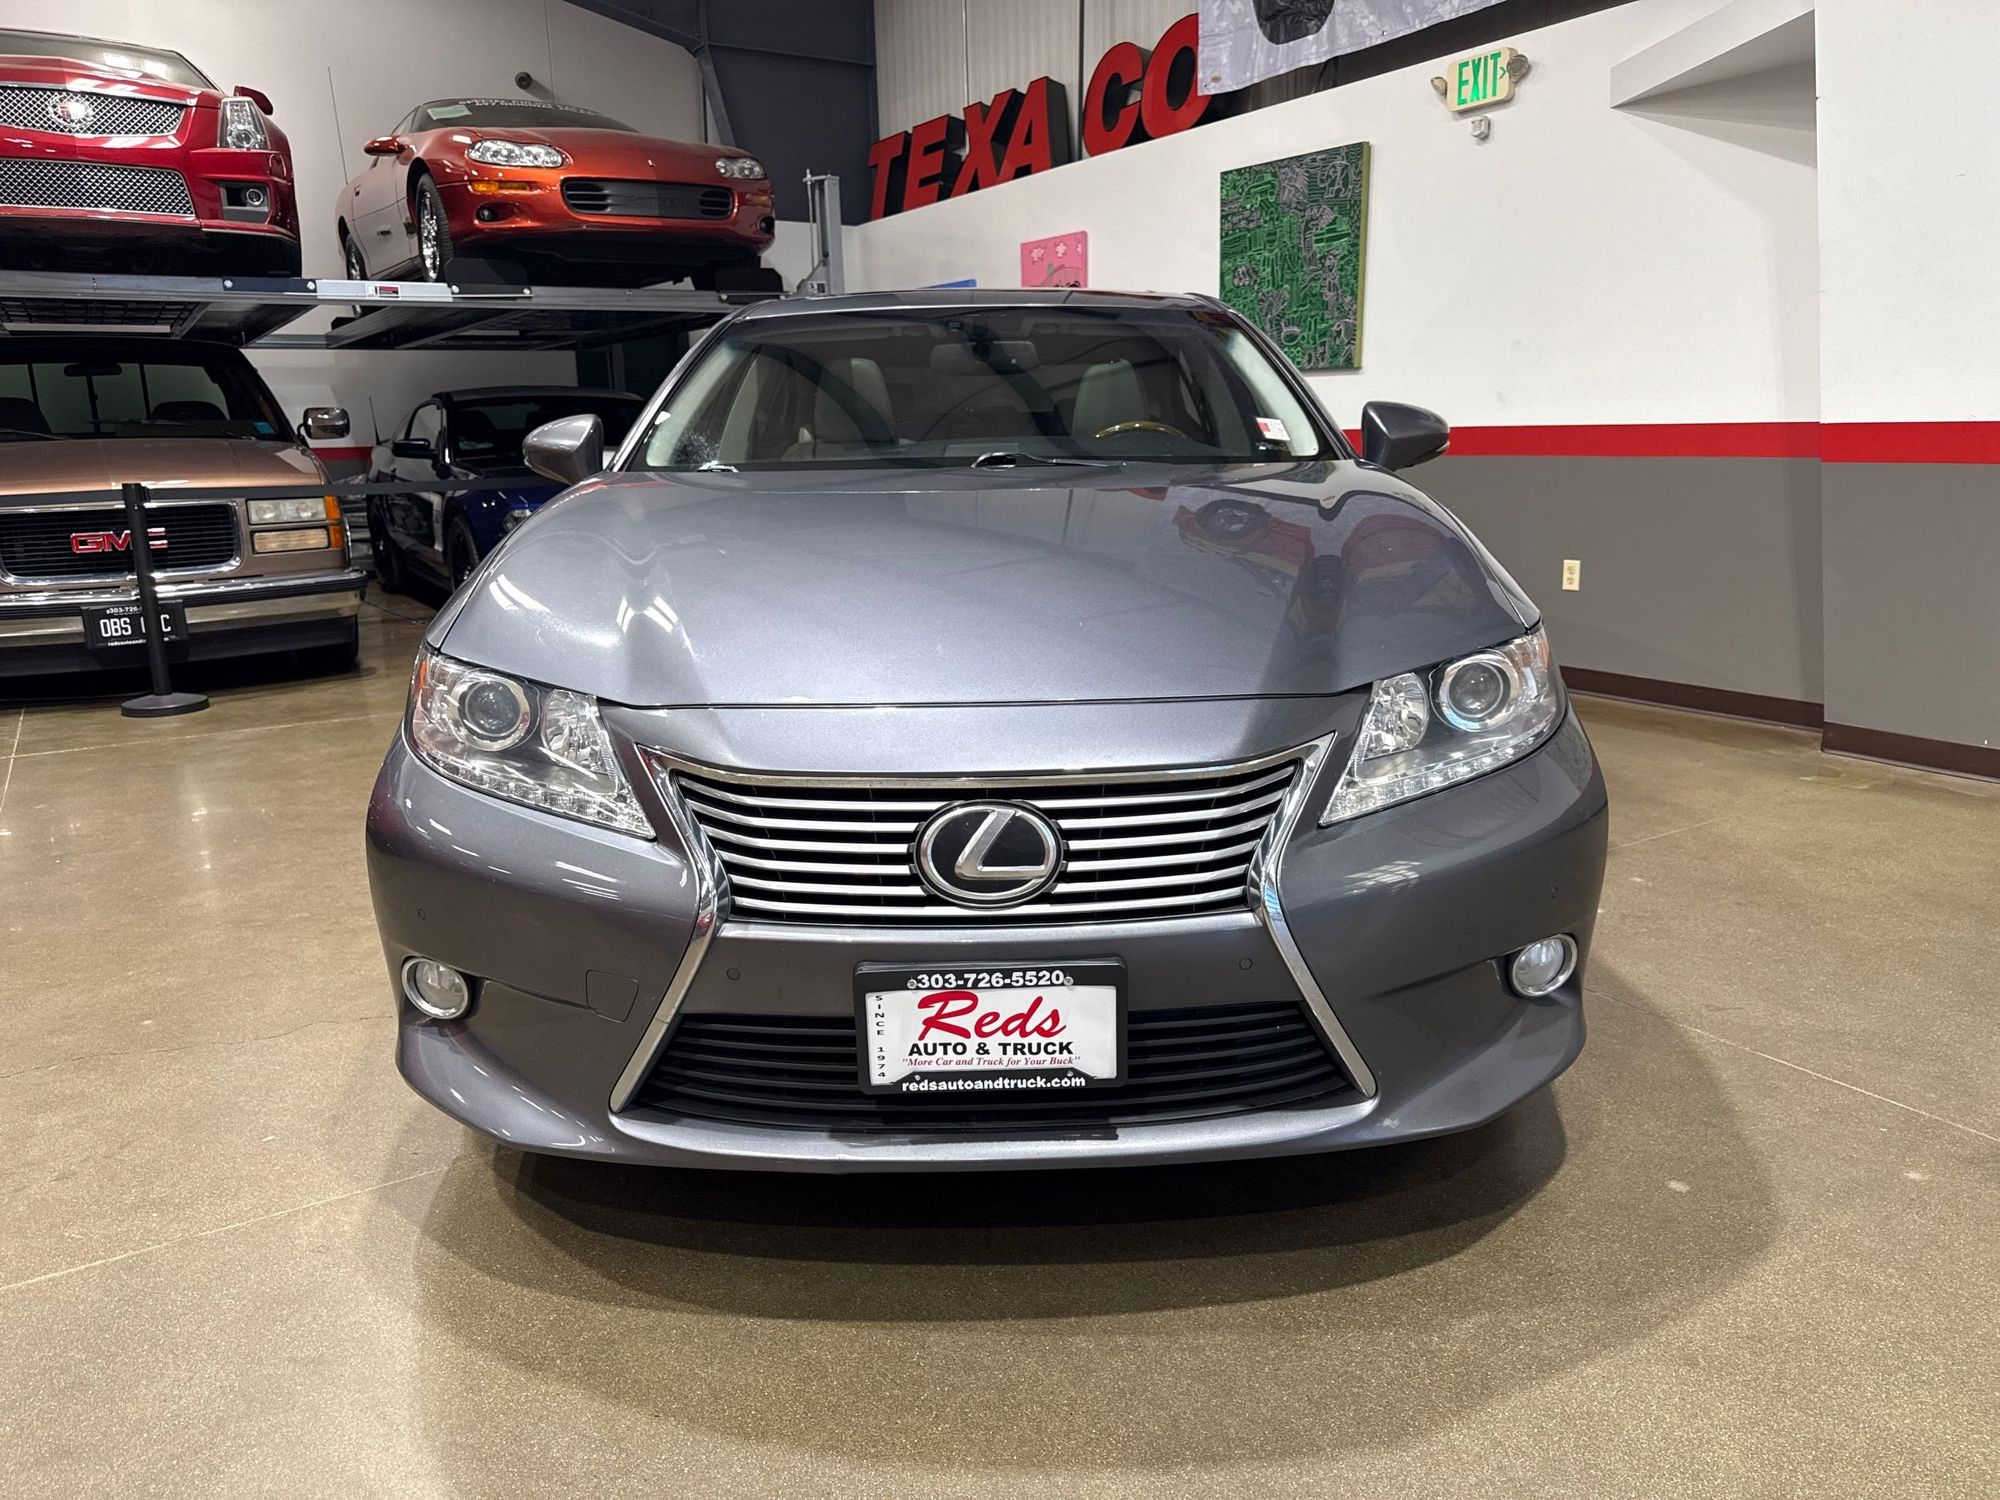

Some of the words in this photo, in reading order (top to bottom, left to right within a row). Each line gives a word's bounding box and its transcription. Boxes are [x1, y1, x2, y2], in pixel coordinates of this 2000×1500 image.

[1457, 51, 1502, 106] EXIT
[99, 618, 132, 637] OBS
[917, 970, 1064, 989] 303-726-5520
[875, 995, 885, 1036] SINCE
[917, 991, 1067, 1041] Reds
[908, 1042, 967, 1056] AUTO
[975, 1042, 991, 1056] &
[998, 1041, 1074, 1056] TRUCK
[877, 1046, 886, 1078] 1974
[902, 1058, 933, 1067] "More
[935, 1057, 953, 1066] Car
[955, 1057, 974, 1066] and
[976, 1056, 1004, 1066] Truck
[1005, 1056, 1020, 1067] for
[1023, 1056, 1047, 1065] Your
[1049, 1056, 1081, 1065] Buck"
[902, 1075, 1086, 1092] redsautoandtruck.com
